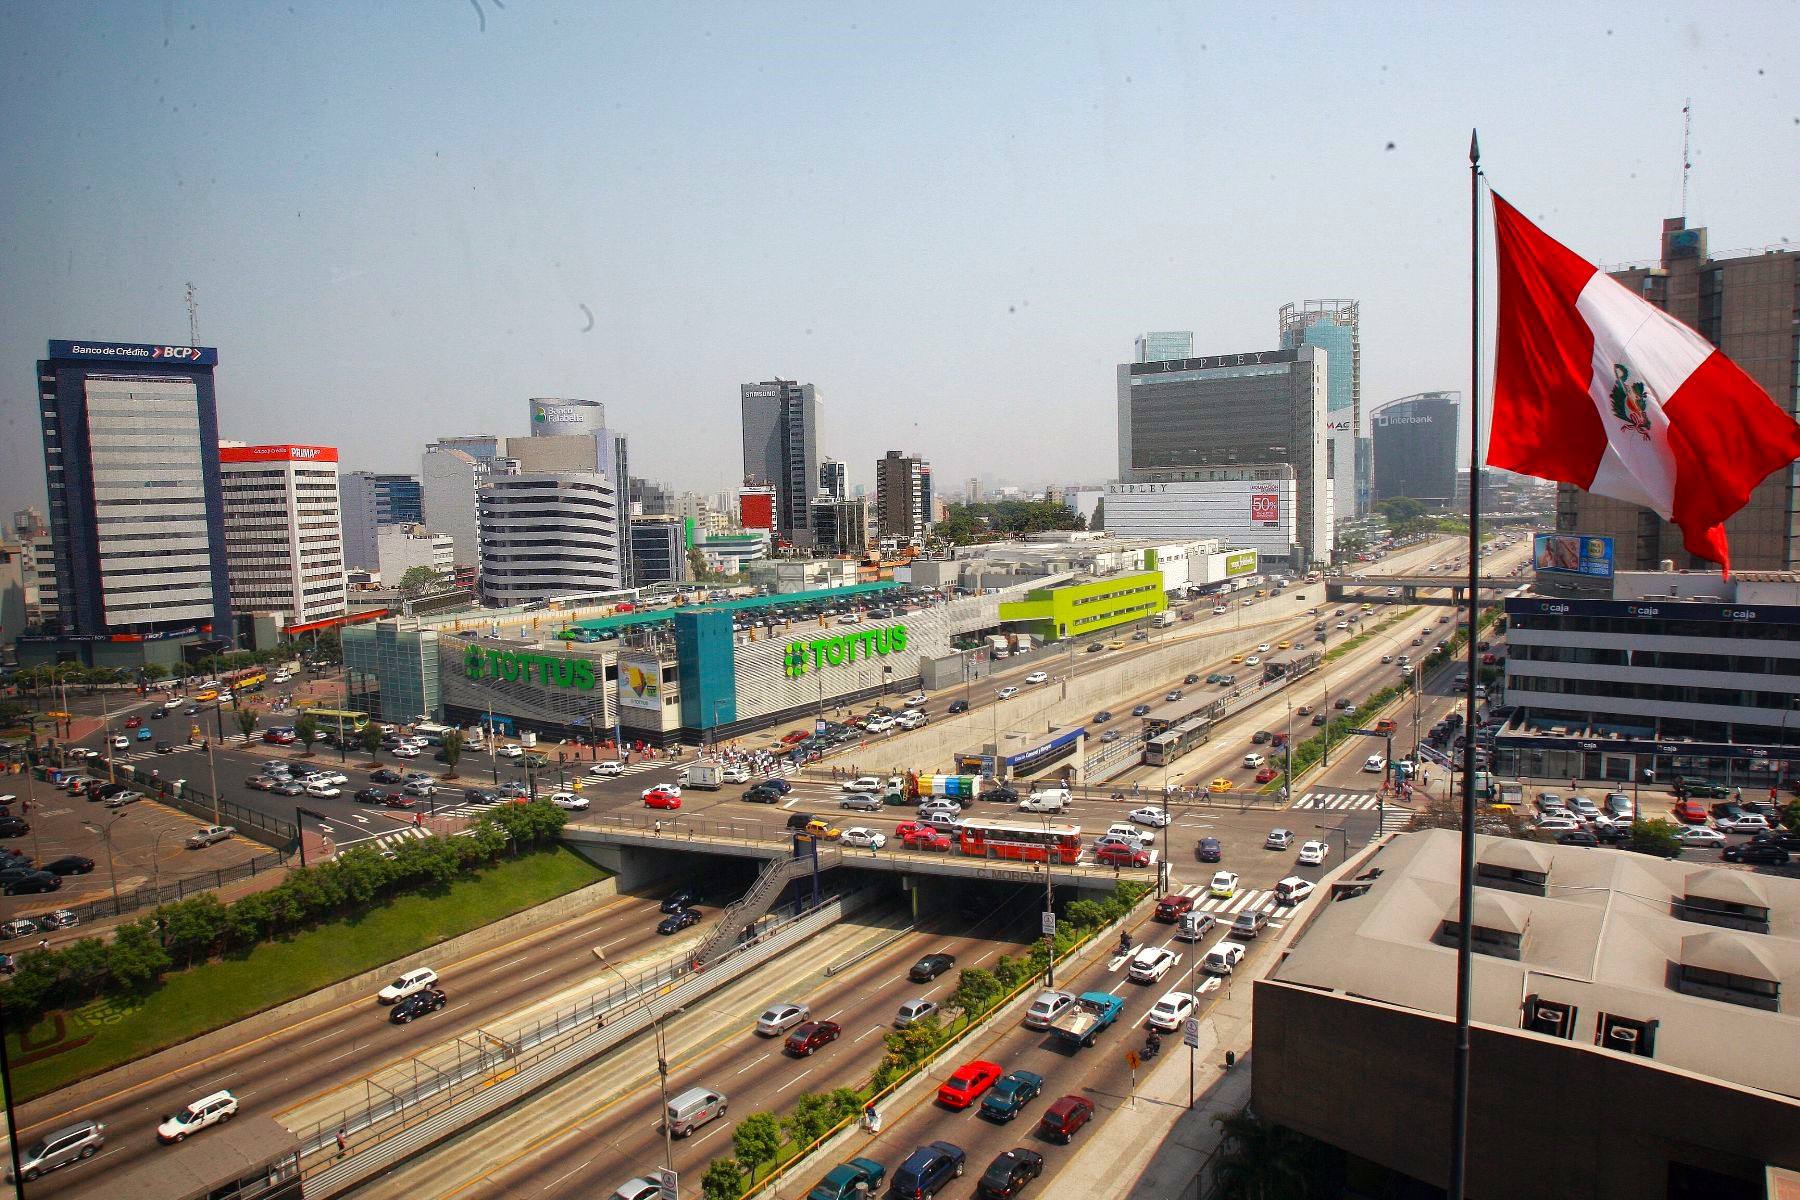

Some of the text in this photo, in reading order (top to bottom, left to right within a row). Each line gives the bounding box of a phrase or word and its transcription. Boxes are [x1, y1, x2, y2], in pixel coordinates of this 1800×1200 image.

[72, 345, 102, 354] Banco
[116, 347, 149, 357] Crédito
[163, 347, 193, 358] BCP
[1162, 352, 1264, 372] RIPLEY
[745, 390, 776, 398] SAMSUNG
[548, 414, 584, 423] Falabella
[1390, 415, 1433, 425] Interbank
[291, 447, 315, 458] PRIMA
[1110, 484, 1168, 494] RIPLEY
[1252, 497, 1278, 511] 50%
[1550, 604, 1569, 612] caja
[1637, 606, 1658, 615] caja
[1732, 610, 1756, 619] caja
[810, 624, 908, 669] TOTTUS
[485, 649, 596, 690] TOTTUS
